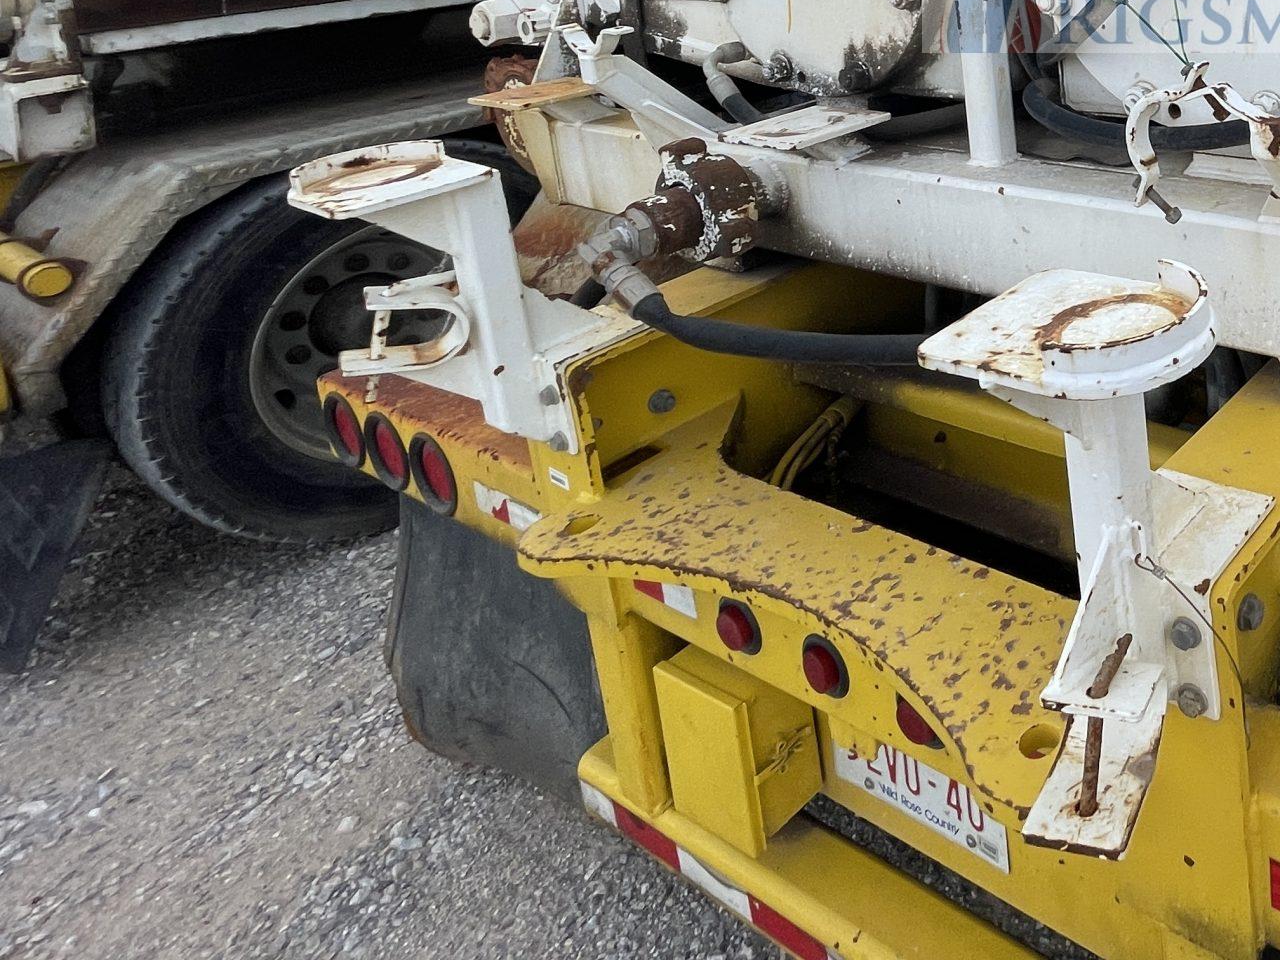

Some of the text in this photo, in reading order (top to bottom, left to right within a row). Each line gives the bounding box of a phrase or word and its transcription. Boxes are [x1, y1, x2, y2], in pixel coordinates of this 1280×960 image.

[878, 783, 960, 836] Wild Rose Country
